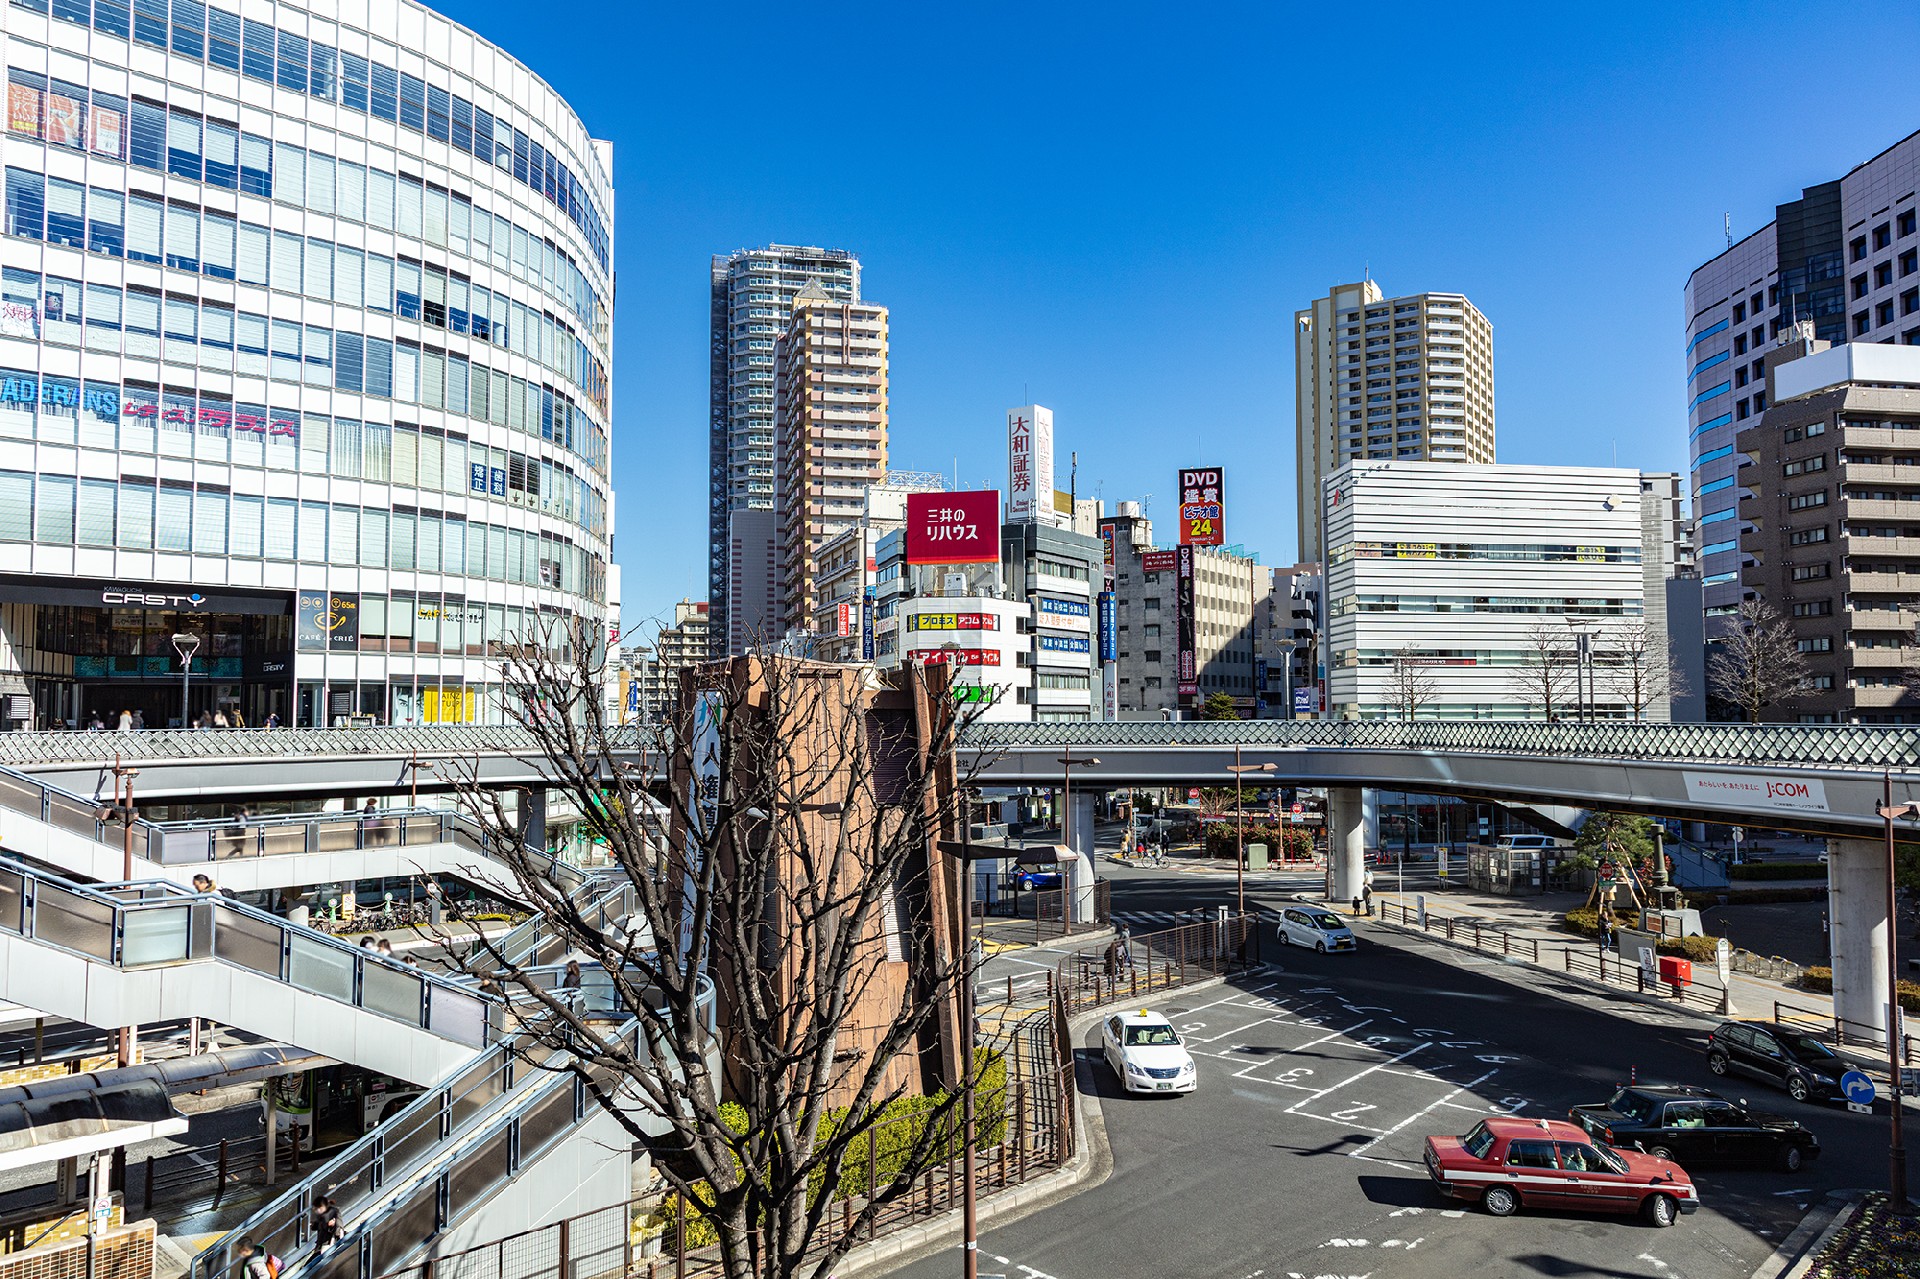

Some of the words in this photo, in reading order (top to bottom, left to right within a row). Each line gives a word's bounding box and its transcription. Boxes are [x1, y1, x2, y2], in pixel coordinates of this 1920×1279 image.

[1, 378, 118, 415] ADERANS
[1012, 417, 1030, 493] 大和証券
[474, 464, 484, 492] 矯正
[493, 469, 503, 496] 歯科
[1184, 472, 1218, 487] DVD
[1184, 487, 1218, 504] 鑑賞
[926, 507, 966, 523] 三井の
[1183, 504, 1220, 520] ビデオ館
[926, 523, 979, 541] リハウス
[1190, 519, 1212, 536] 24
[102, 592, 206, 607] CASTY
[922, 615, 954, 625] プロミス
[958, 616, 980, 625] アコム
[1106, 681, 1114, 718] 大和証券
[1766, 782, 1810, 798] J:COM
[1275, 1067, 1315, 1083] 3
[1330, 1100, 1378, 1121] 2
